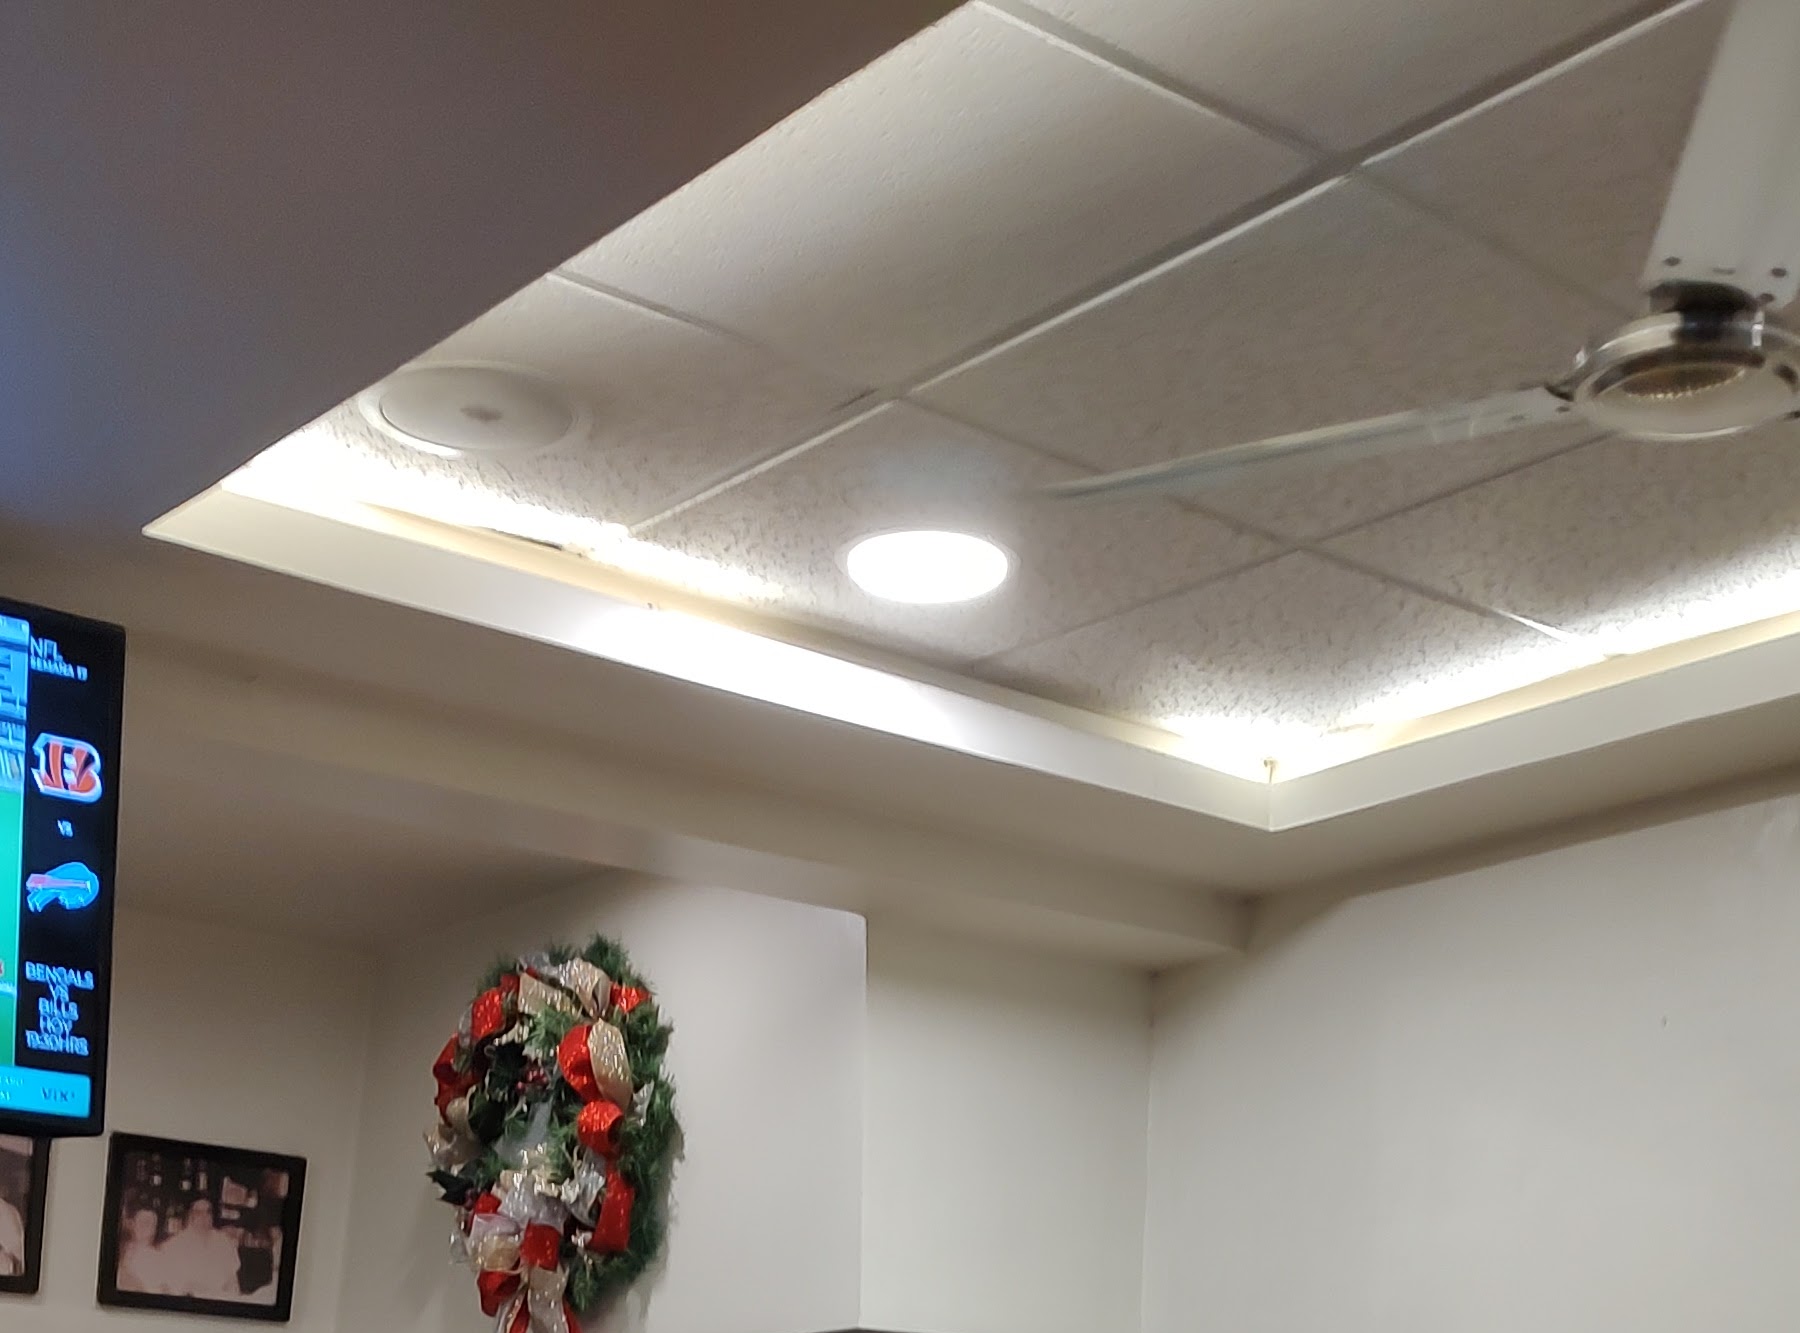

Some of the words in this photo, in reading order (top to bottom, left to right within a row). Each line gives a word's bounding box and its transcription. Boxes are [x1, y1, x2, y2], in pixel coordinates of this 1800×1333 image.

[30, 635, 63, 660] NFL
[26, 961, 94, 990] BENGALS
[39, 997, 79, 1021] BILLS
